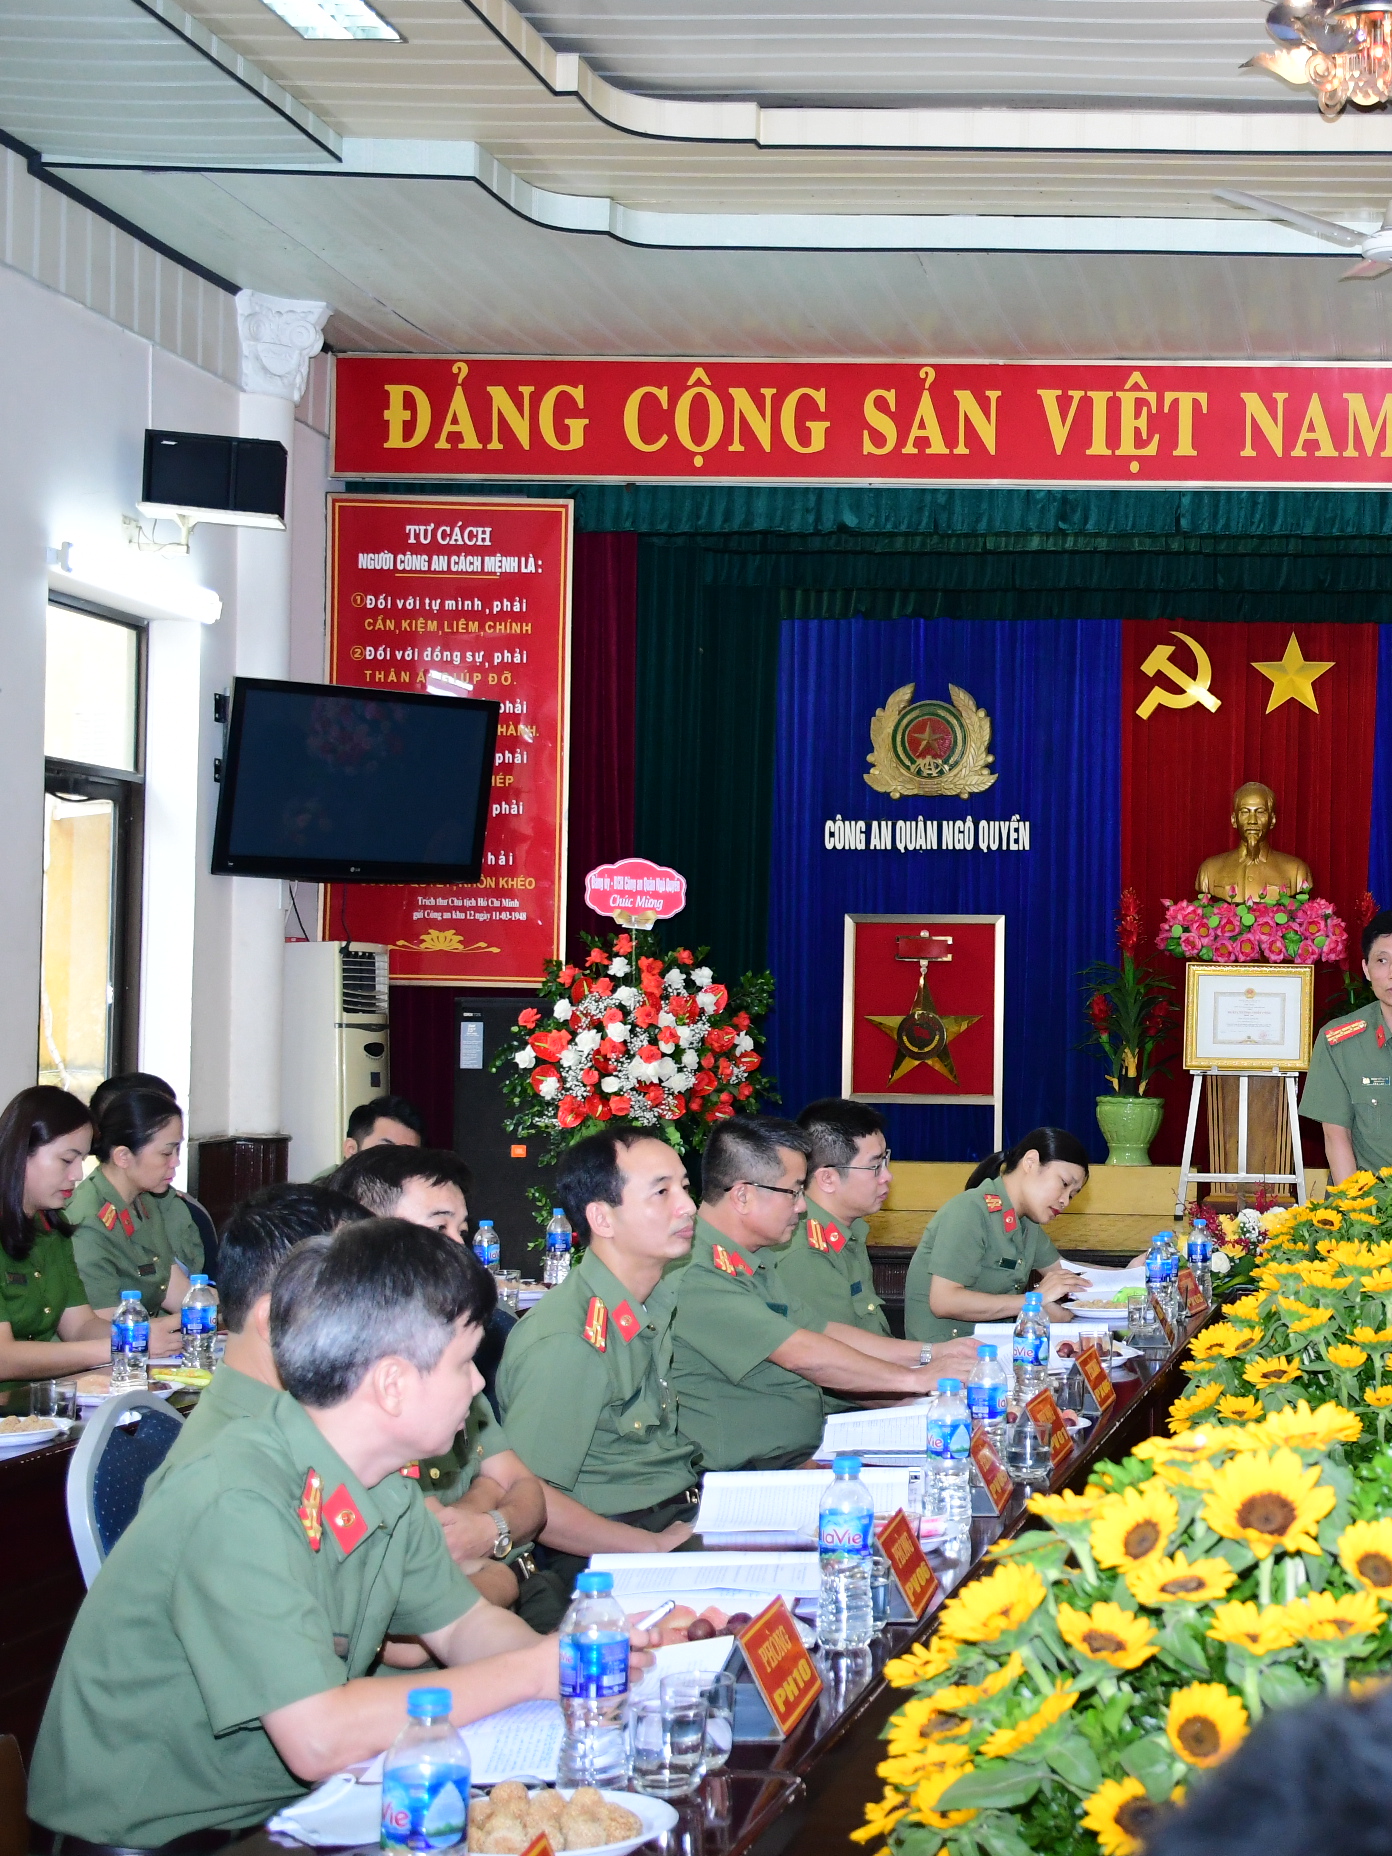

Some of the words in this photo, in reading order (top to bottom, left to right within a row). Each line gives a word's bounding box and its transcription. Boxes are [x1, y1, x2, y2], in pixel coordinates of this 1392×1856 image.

[384, 362, 589, 450] ĐẢNG
[623, 367, 830, 467] CỘNG
[862, 366, 1001, 455] SẢN
[1037, 372, 1207, 473] VIỆT
[406, 523, 434, 543] TƯ
[437, 522, 492, 545] CÁCH
[359, 551, 393, 569] NGƯỜI
[397, 552, 428, 570] CÔNG
[431, 556, 447, 571] AN
[451, 554, 481, 572] CÁCH
[484, 554, 518, 575] MỆNH
[366, 594, 391, 609] Đối
[397, 596, 419, 609] với
[425, 597, 440, 613] tự
[493, 597, 527, 614] phải
[485, 619, 532, 634] CHÍNH
[365, 645, 390, 660] Đối
[396, 647, 418, 660] với
[423, 646, 461, 664] đồng
[494, 649, 527, 665] phải
[365, 668, 410, 683] THÂN
[495, 748, 527, 766] phải
[492, 800, 523, 817] phải
[825, 814, 865, 850] CÔNG
[870, 820, 891, 850] AN
[896, 816, 937, 853] QUẬN
[942, 816, 974, 850] NGÔ
[979, 814, 1030, 852] QUYỀN
[499, 874, 536, 889] KHÉO
[502, 899, 519, 907] Minh
[610, 895, 633, 907] Chúc
[453, 911, 465, 919] khu
[467, 911, 474, 919] 12
[822, 1528, 862, 1545] laVie
[773, 1665, 812, 1714] PH10
[381, 1801, 410, 1829] Vie
